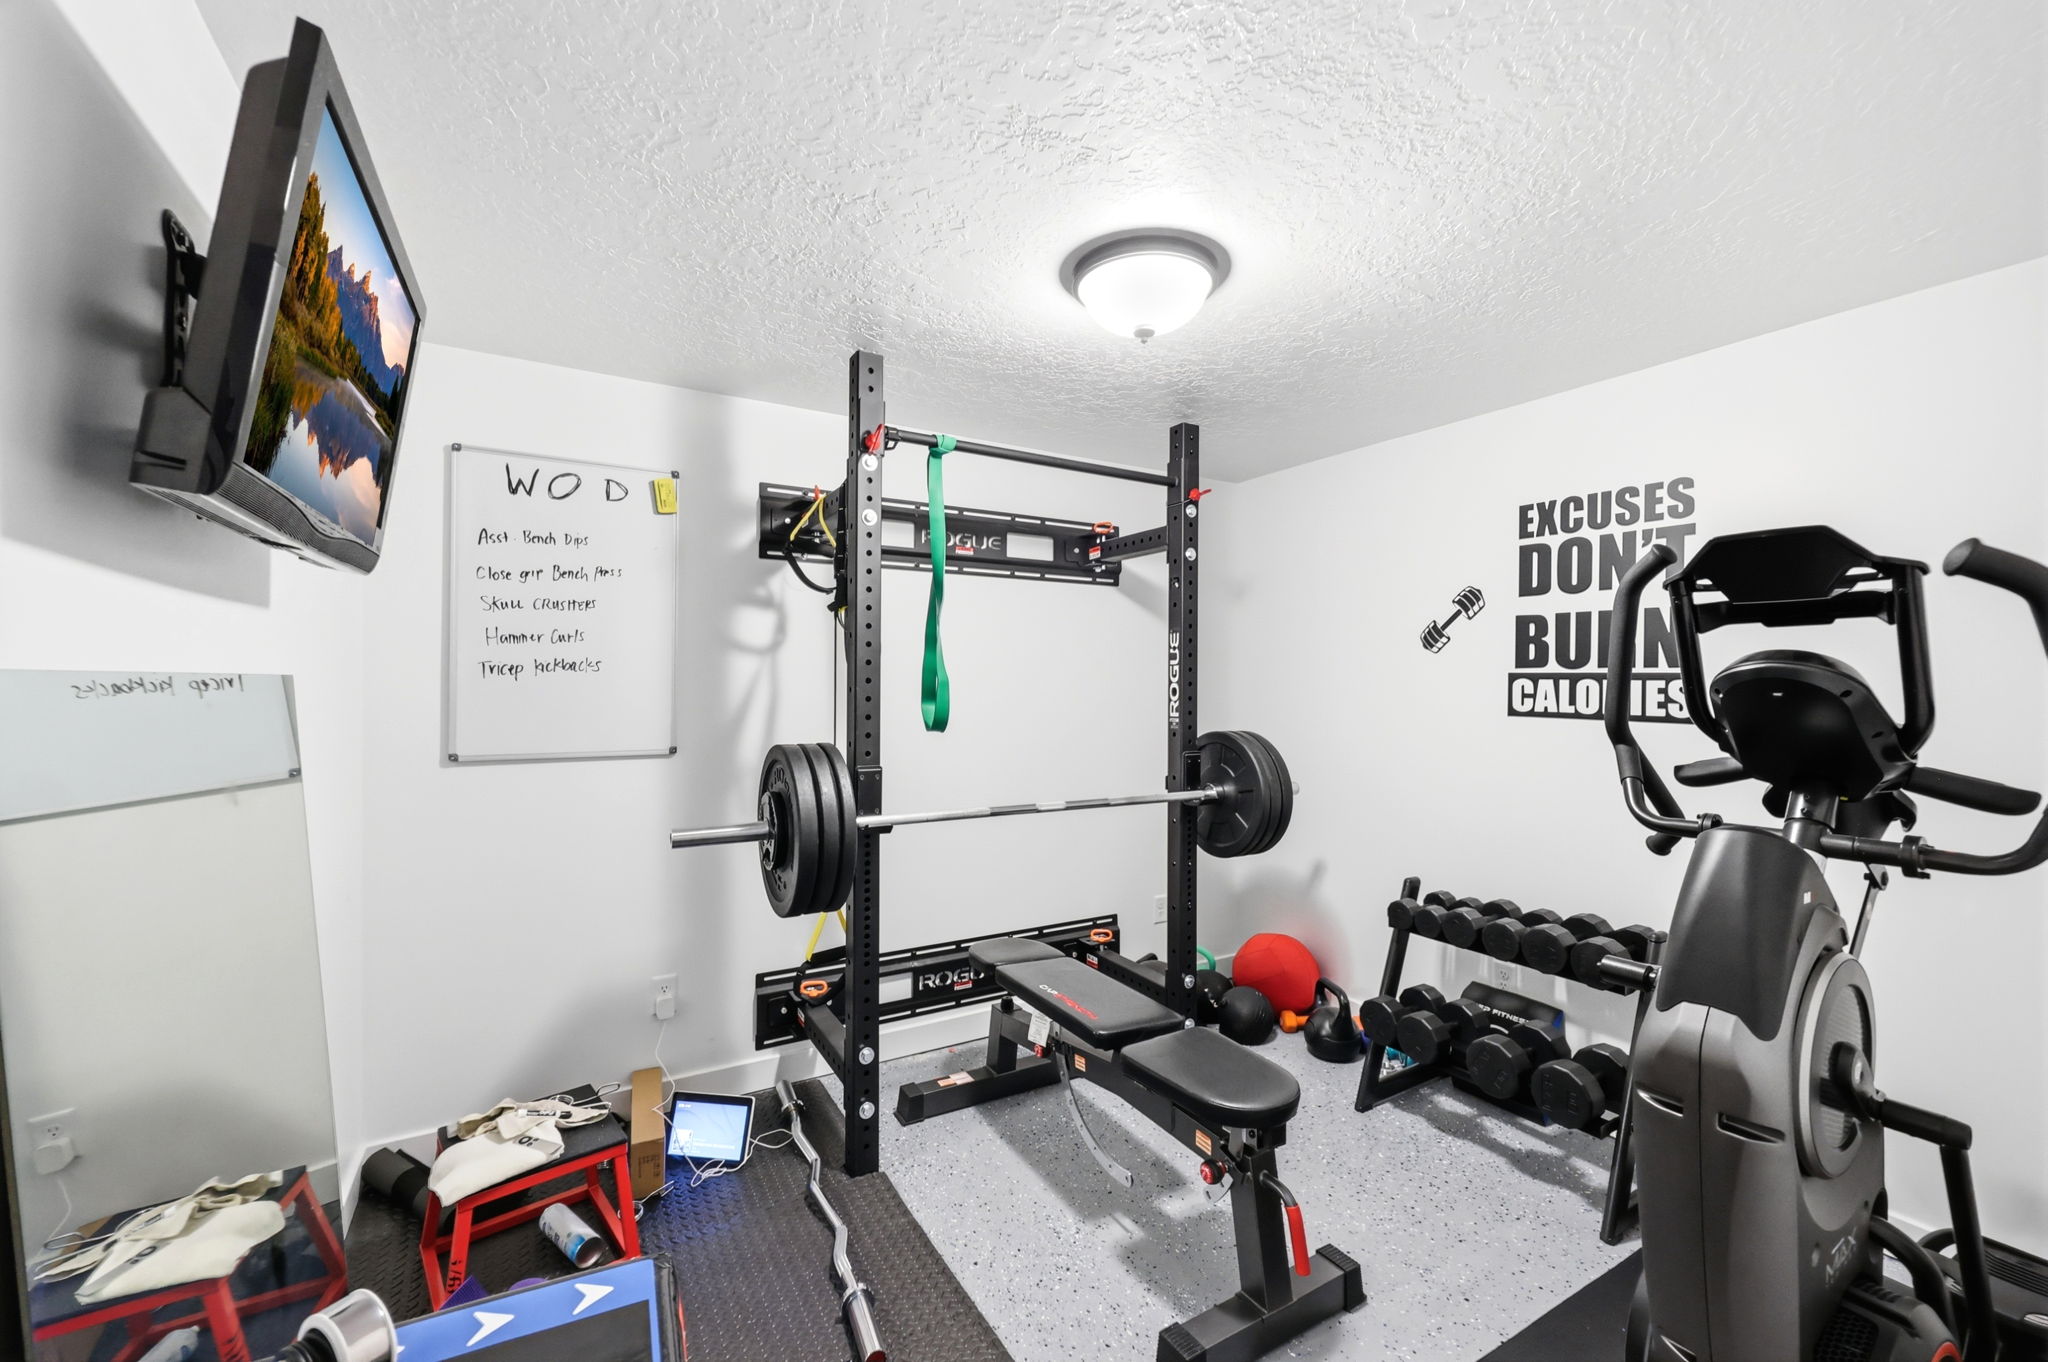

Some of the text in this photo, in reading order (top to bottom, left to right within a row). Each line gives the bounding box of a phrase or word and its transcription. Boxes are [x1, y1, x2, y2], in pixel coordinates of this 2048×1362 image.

[1518, 476, 1696, 540] EXCUSES
[522, 529, 557, 546] Bench
[564, 532, 589, 550] Dips
[1518, 522, 1697, 598] DON'T
[475, 565, 512, 582] Close
[551, 563, 589, 583] Bench
[485, 625, 585, 647] Hammer Curls
[477, 659, 525, 682] Tricep
[1169, 631, 1180, 718] ROGUE
[1511, 677, 1691, 719] CALOIES
[918, 965, 986, 992] ROGU
[1491, 1007, 1530, 1026] FITNES
